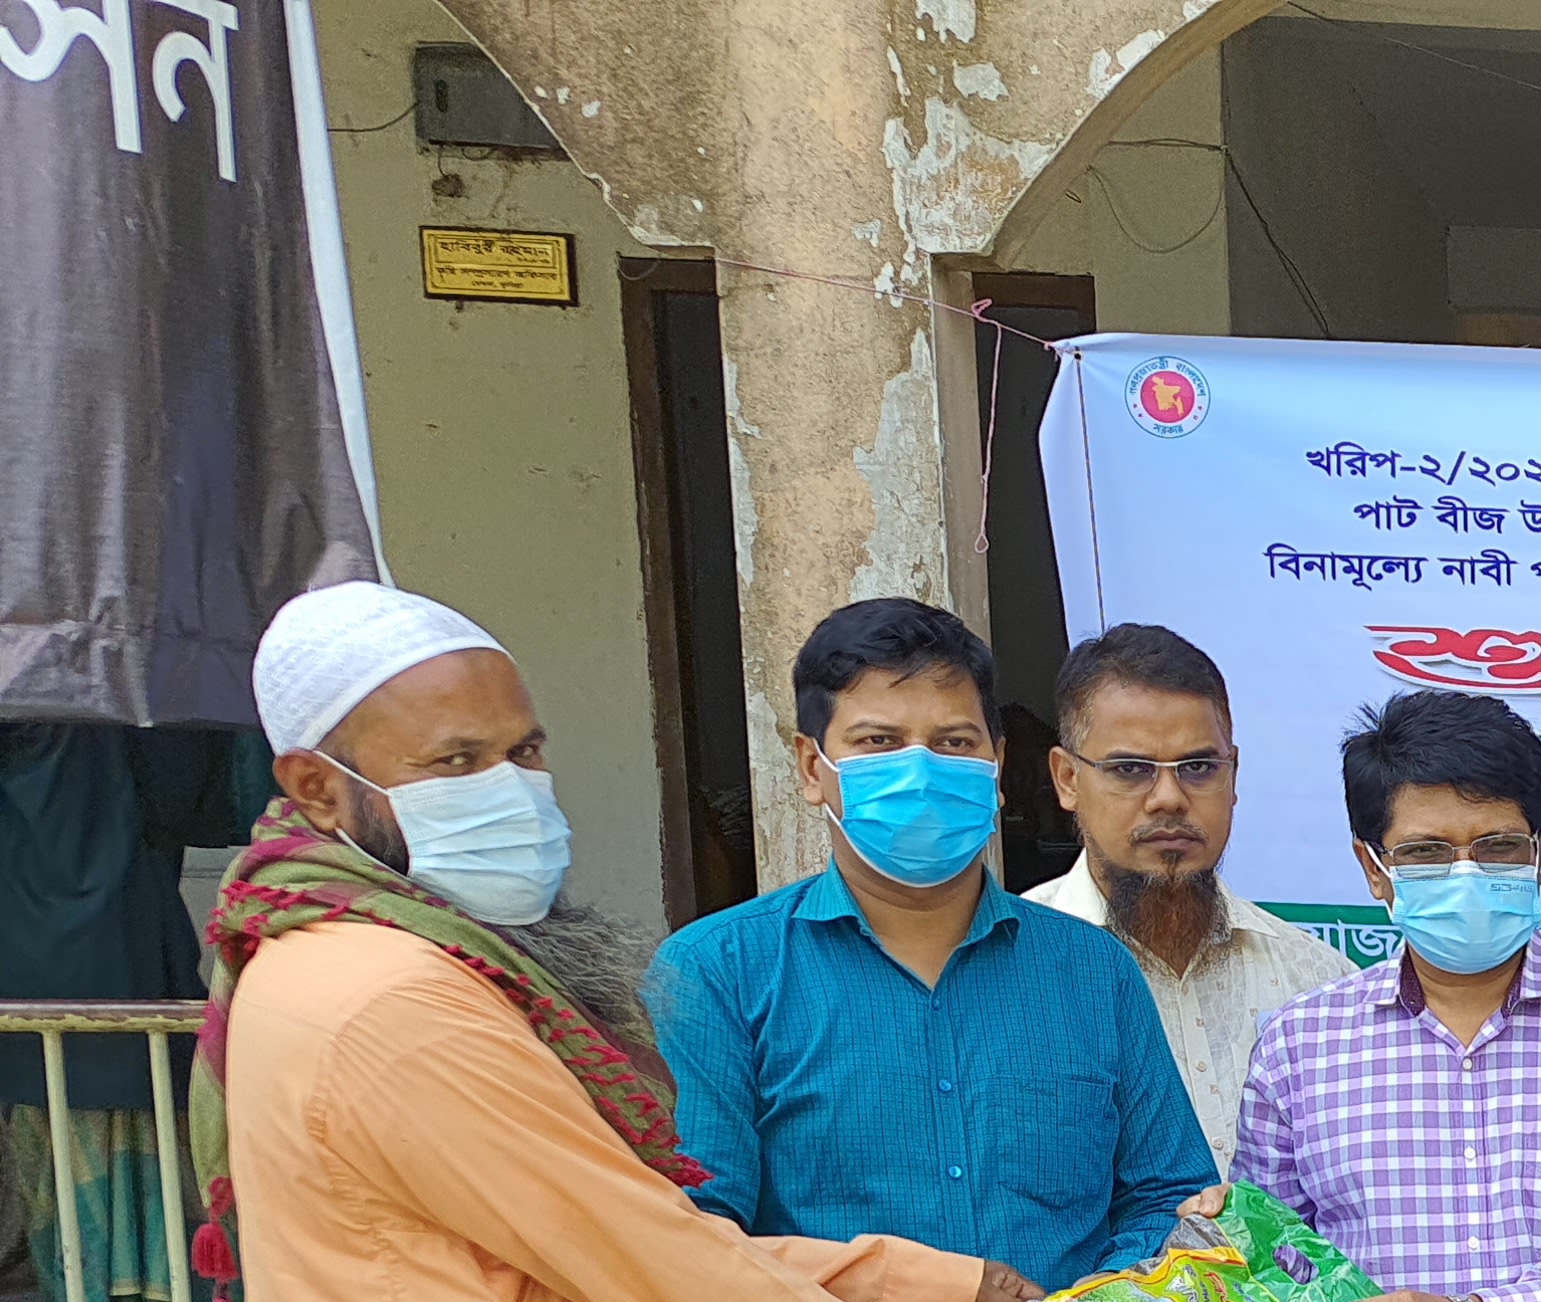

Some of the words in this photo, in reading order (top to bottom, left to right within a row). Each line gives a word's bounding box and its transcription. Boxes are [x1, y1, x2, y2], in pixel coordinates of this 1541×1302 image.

[1354, 496, 1422, 530] পাট
[1436, 494, 1507, 535] বীজ
[1265, 545, 1423, 588] বিনামূল্যে
[1440, 548, 1517, 589] নাবী
